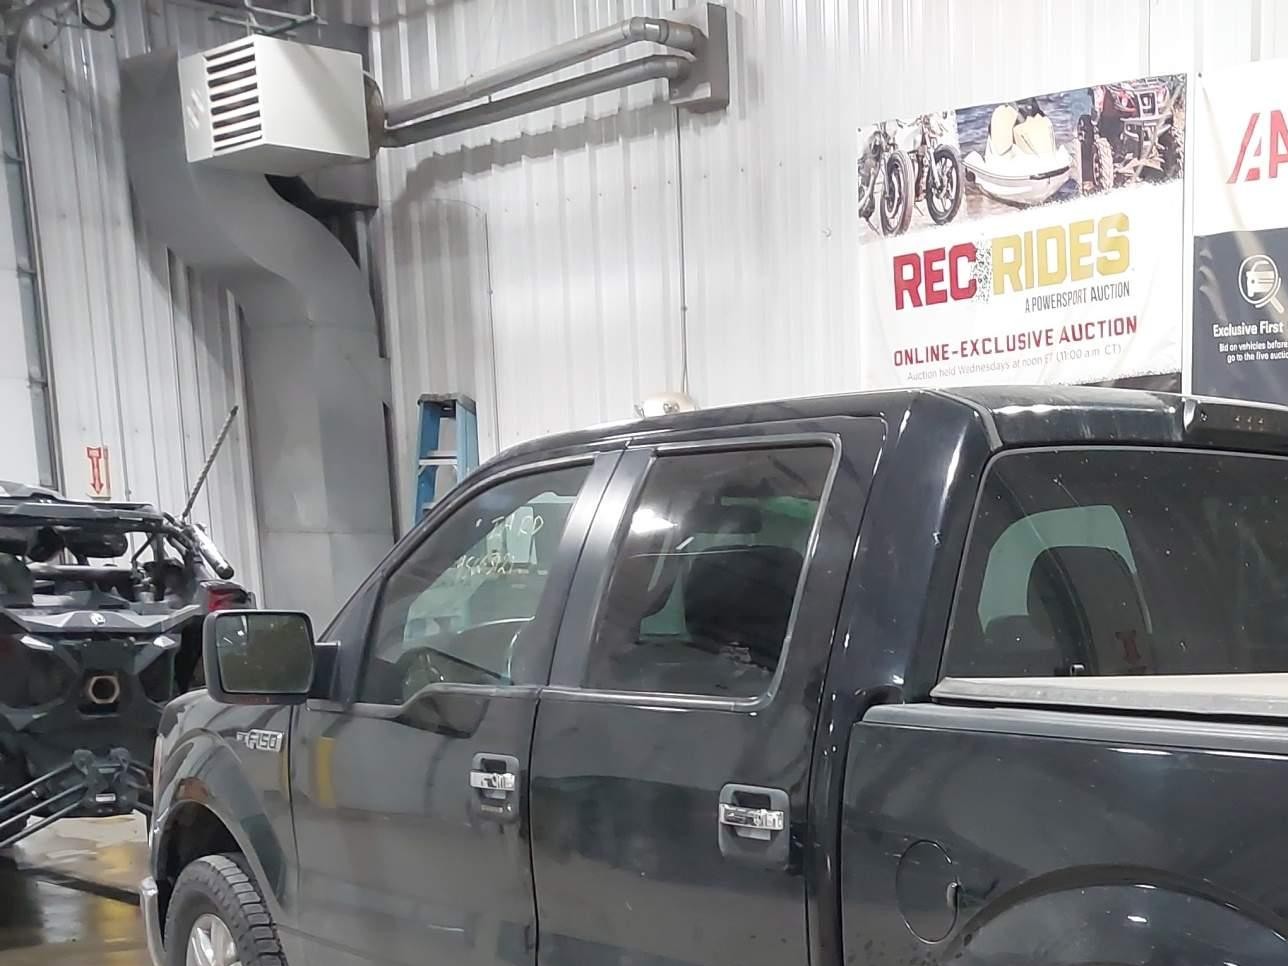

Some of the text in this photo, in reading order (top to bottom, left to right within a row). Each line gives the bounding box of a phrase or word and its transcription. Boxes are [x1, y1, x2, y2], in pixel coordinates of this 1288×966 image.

[893, 211, 1131, 310] REC RIDES
[1025, 279, 1131, 313] A POWERSPORT AUCTION
[1213, 322, 1257, 337] Exclusive
[1260, 321, 1283, 334] First
[893, 315, 1138, 367] ONLINE-EXCLUSIVE AUCTION
[1229, 344, 1238, 352] on
[1238, 341, 1266, 351] vehicles
[1266, 340, 1288, 350] before
[1236, 353, 1244, 362] to
[1244, 352, 1255, 361] the
[907, 369, 938, 381] Auction
